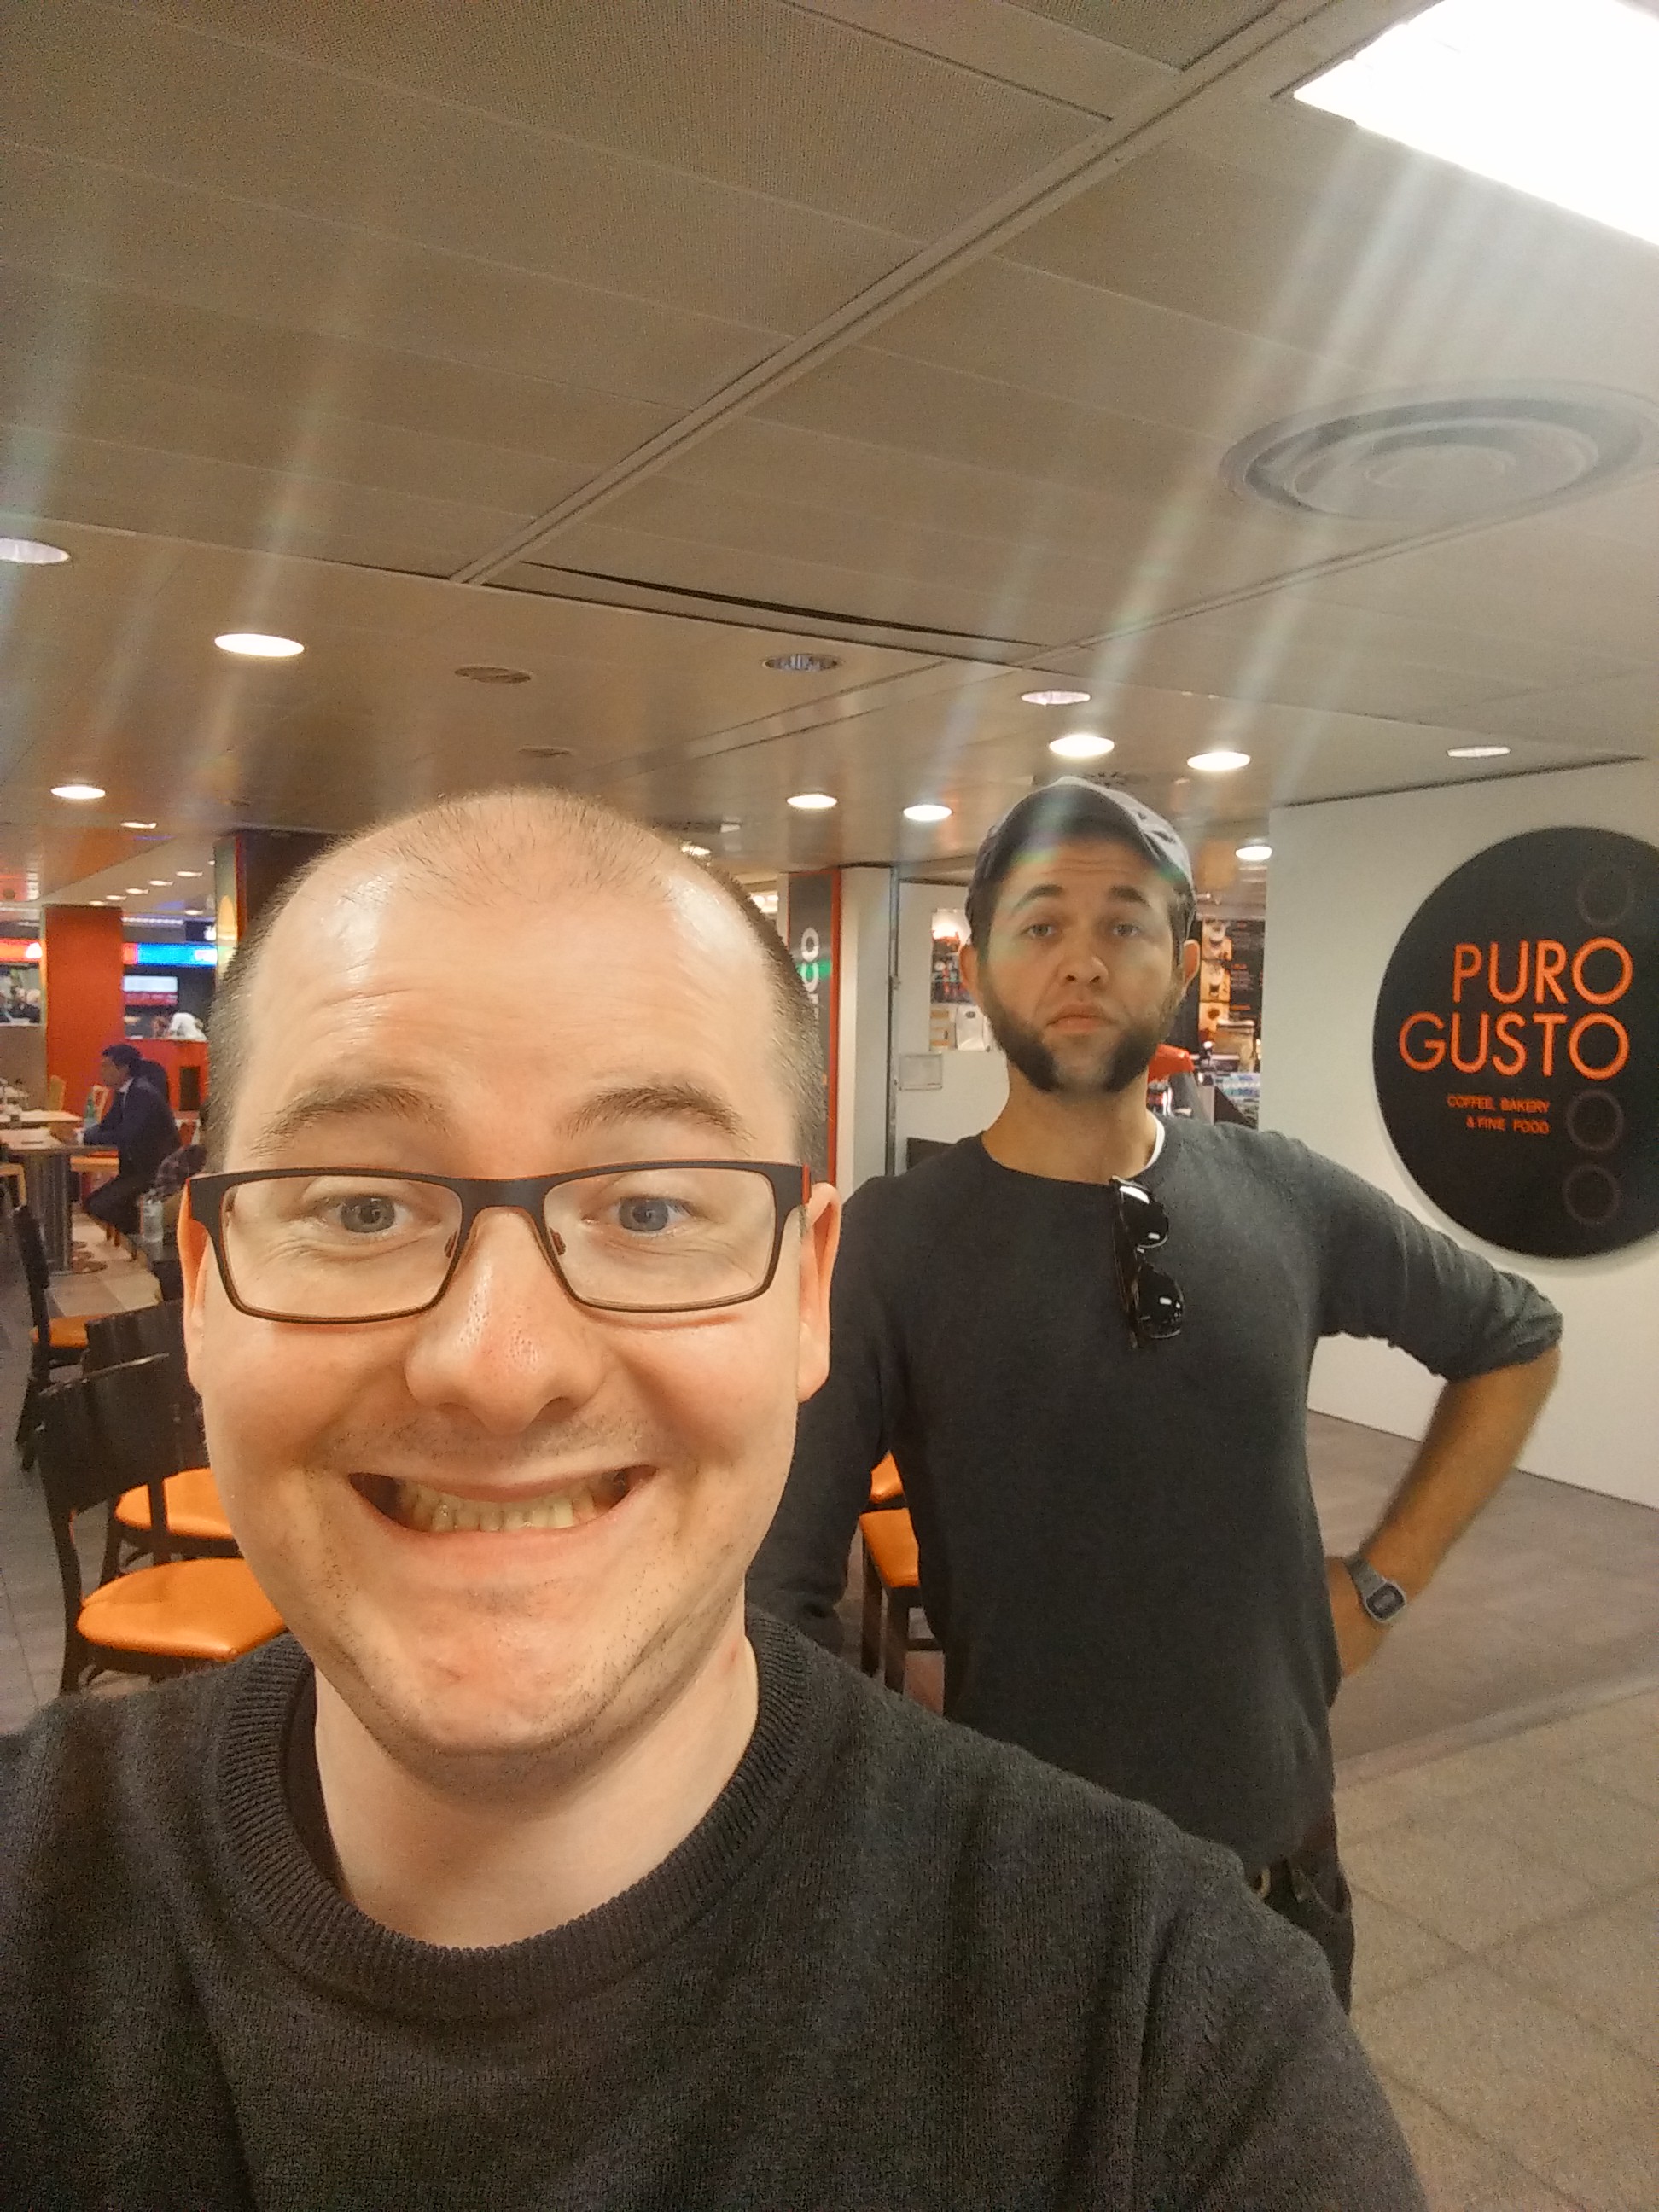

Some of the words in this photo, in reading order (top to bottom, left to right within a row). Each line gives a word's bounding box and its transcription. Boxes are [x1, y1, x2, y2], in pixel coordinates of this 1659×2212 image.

[1452, 937, 1633, 1006] PURO
[1399, 1011, 1630, 1080] GUSTO
[1465, 1115, 1475, 1128] &
[1476, 1116, 1506, 1132] FINE
[1511, 1118, 1551, 1134] FOOD
[1499, 1097, 1551, 1113] BAKERY
